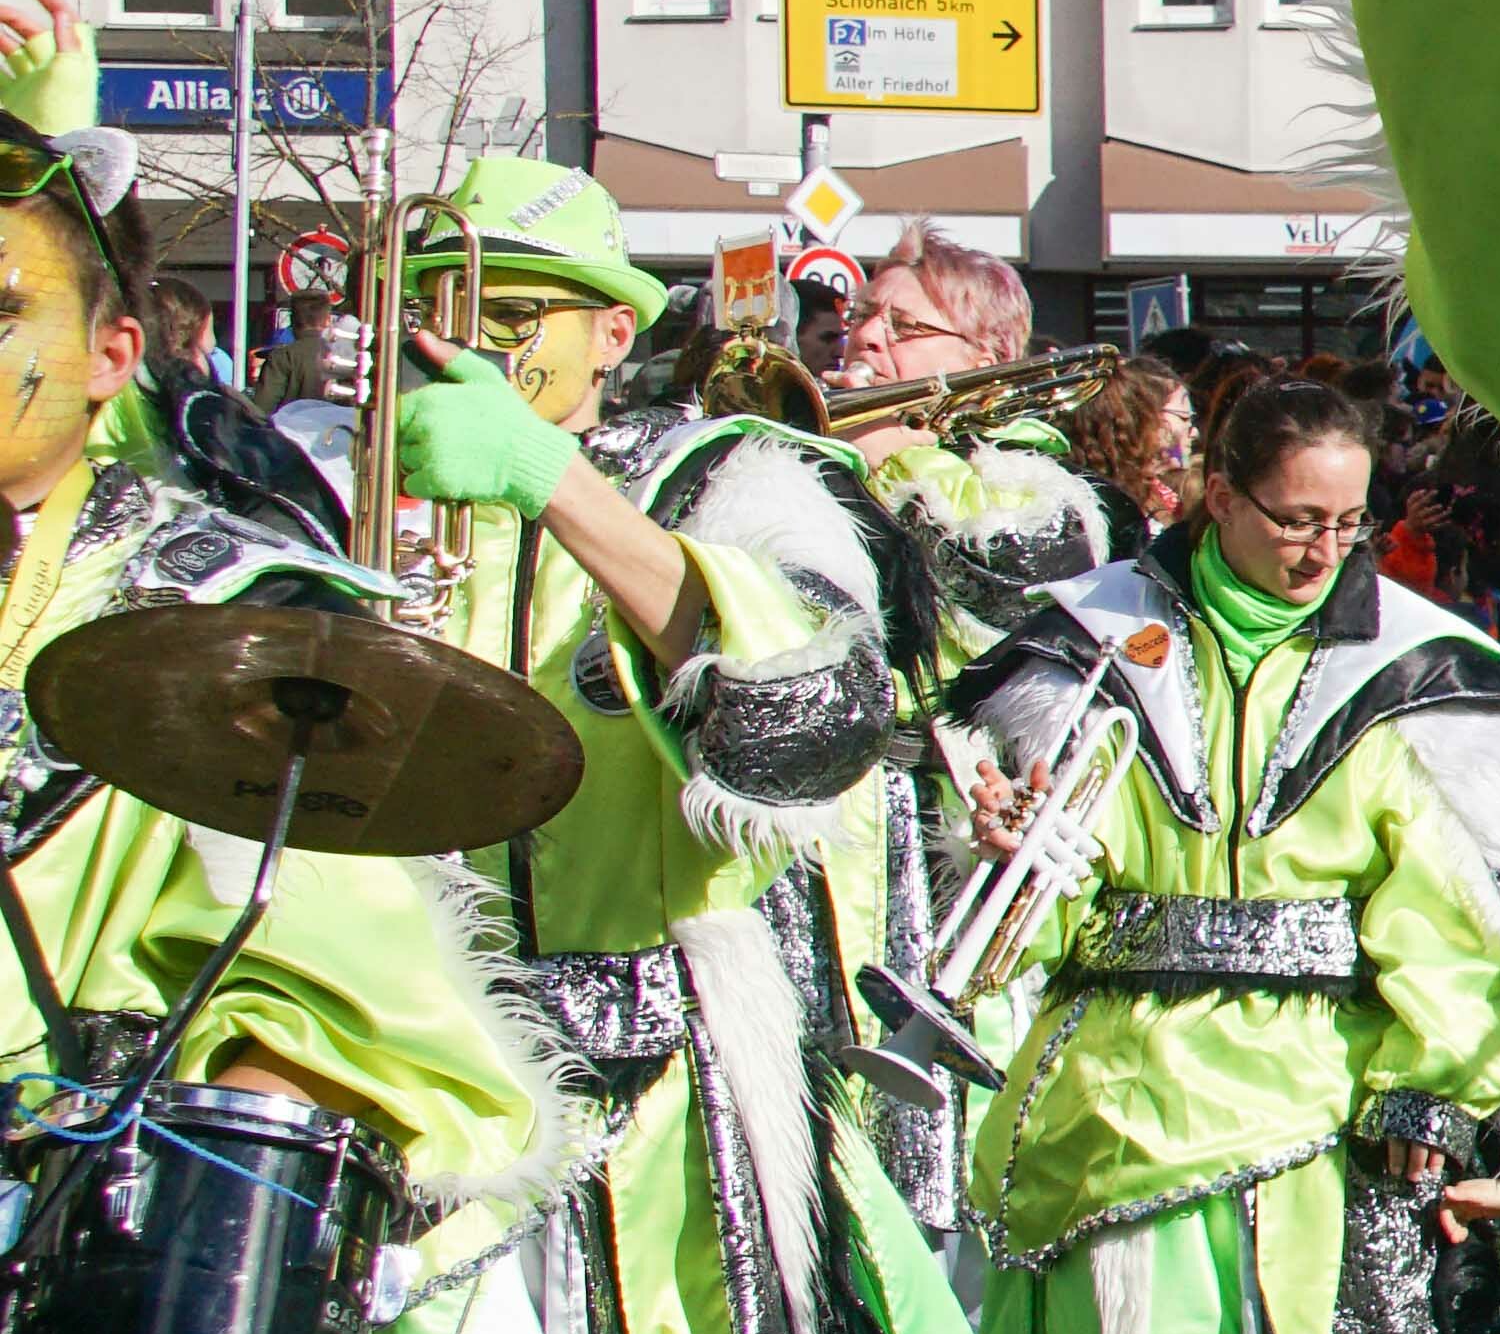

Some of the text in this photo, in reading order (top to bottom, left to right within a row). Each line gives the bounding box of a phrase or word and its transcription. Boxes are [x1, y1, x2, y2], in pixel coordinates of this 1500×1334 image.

[867, 26, 937, 42] Im Höfle
[835, 76, 951, 93] Alter Friedhof
[147, 80, 273, 111] Alliaz
